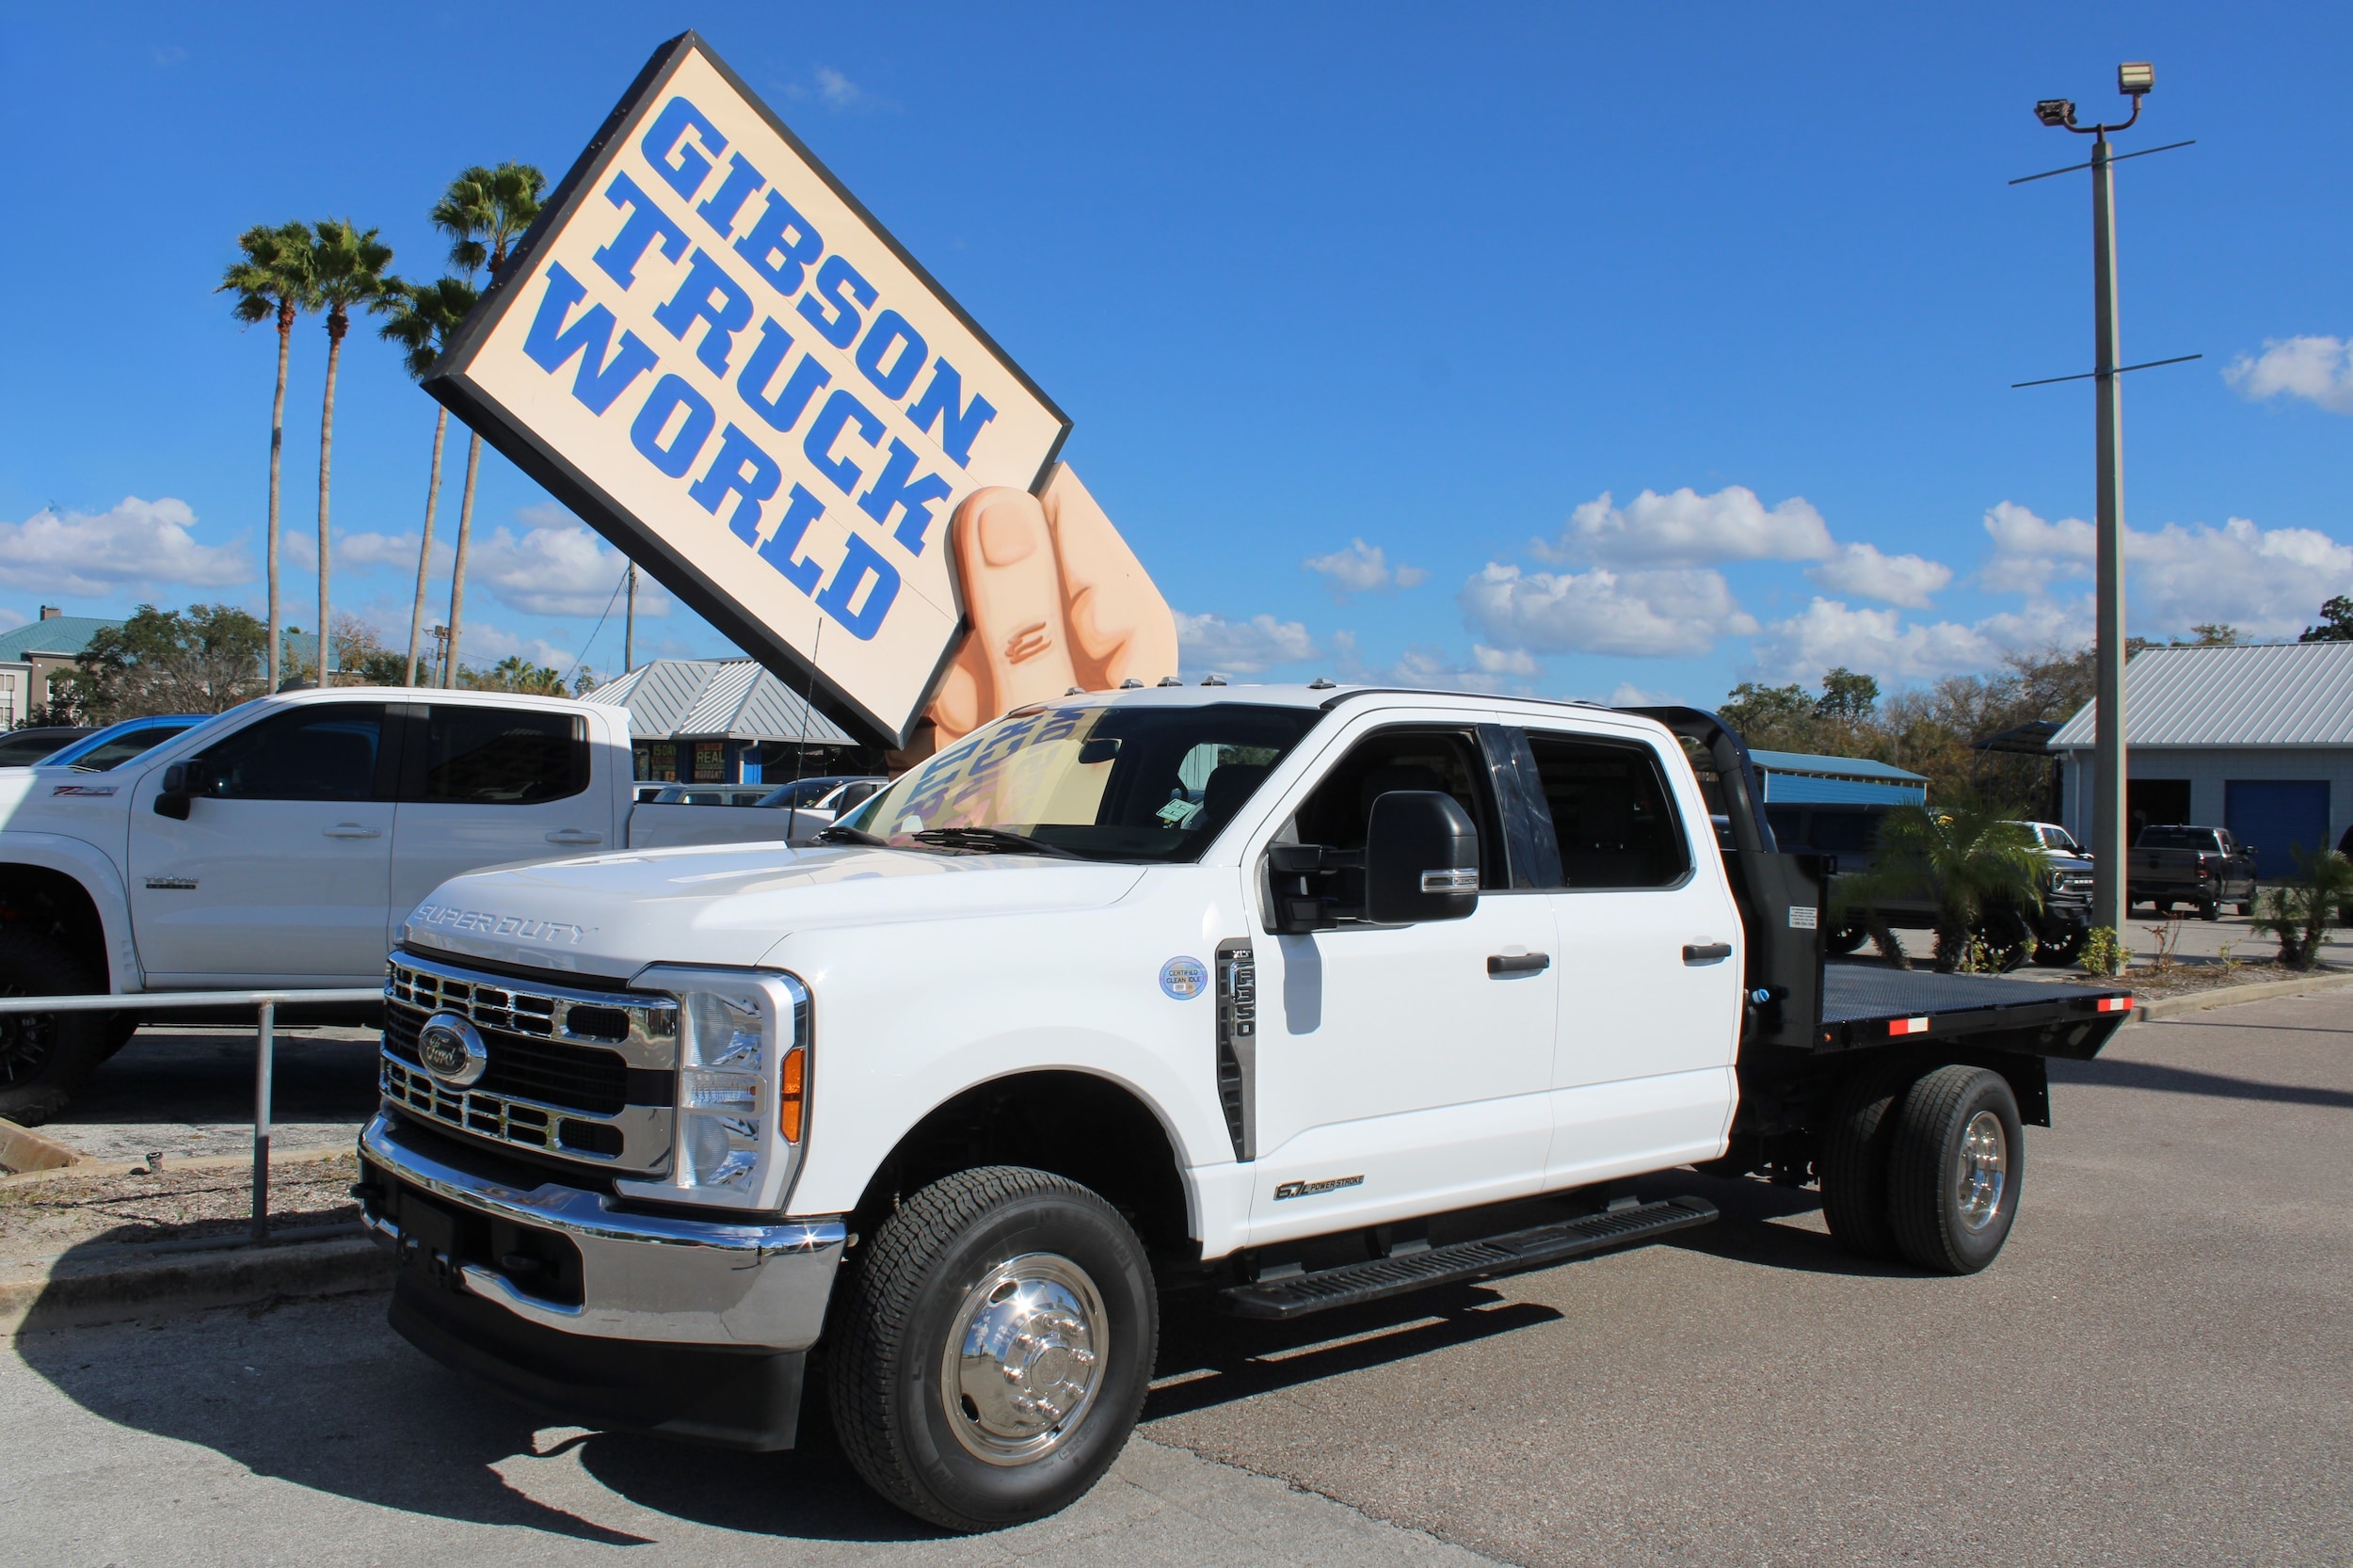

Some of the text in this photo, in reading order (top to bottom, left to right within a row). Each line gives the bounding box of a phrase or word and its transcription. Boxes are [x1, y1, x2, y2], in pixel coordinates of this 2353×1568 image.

[641, 96, 998, 471] GIBSON
[592, 169, 952, 558] TRUCK
[522, 260, 901, 641] WORLD
[663, 744, 676, 757] DAY
[696, 751, 725, 763] REAL
[414, 904, 600, 945] SUPER DUTY
[1232, 950, 1252, 959] XLT
[425, 1032, 457, 1066] Ford
[1310, 1181, 1336, 1192] POWER
[1336, 1175, 1364, 1187] STROKE
